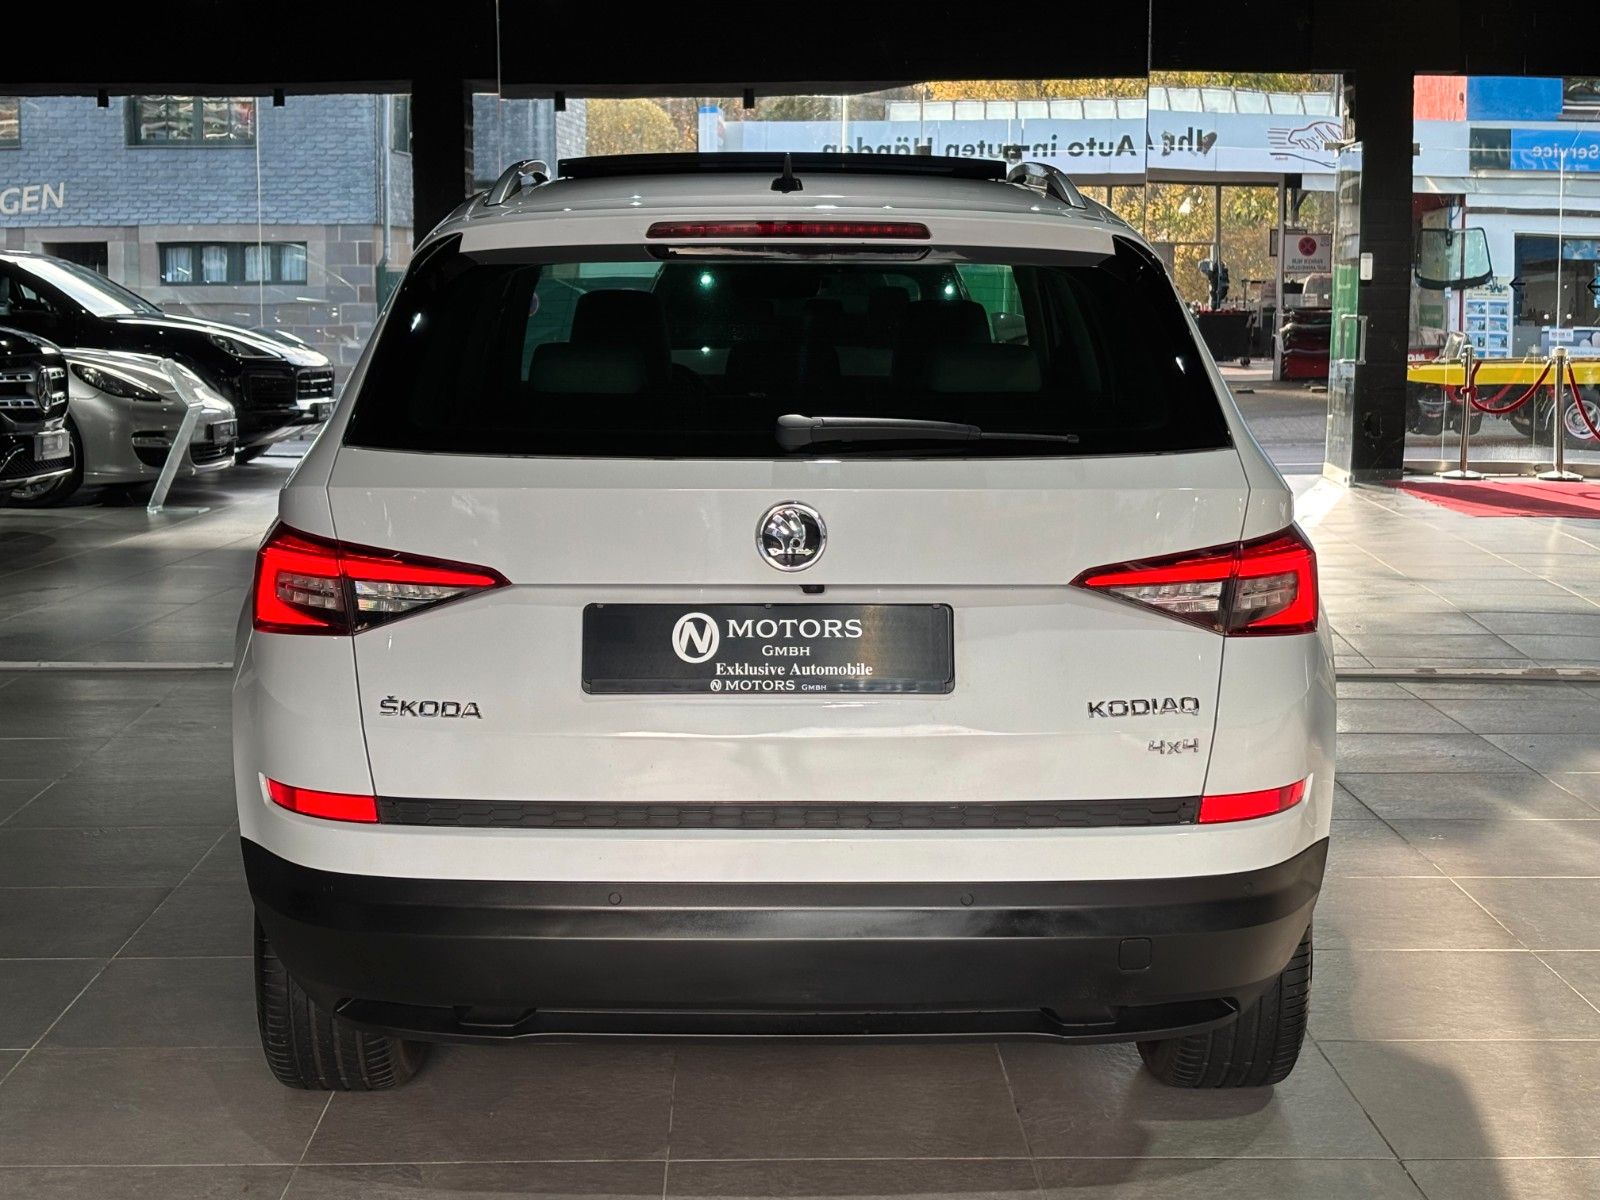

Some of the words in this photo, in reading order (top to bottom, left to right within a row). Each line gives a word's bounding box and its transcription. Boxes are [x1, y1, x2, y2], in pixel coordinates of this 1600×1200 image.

[0, 182, 65, 215] GEN
[726, 618, 863, 638] MOTORS
[715, 662, 785, 676] Exklusive
[789, 662, 873, 676] Automobile
[725, 680, 796, 691] MOTORS
[380, 696, 482, 719] ŠKODA
[1088, 697, 1200, 718] KODIAQ
